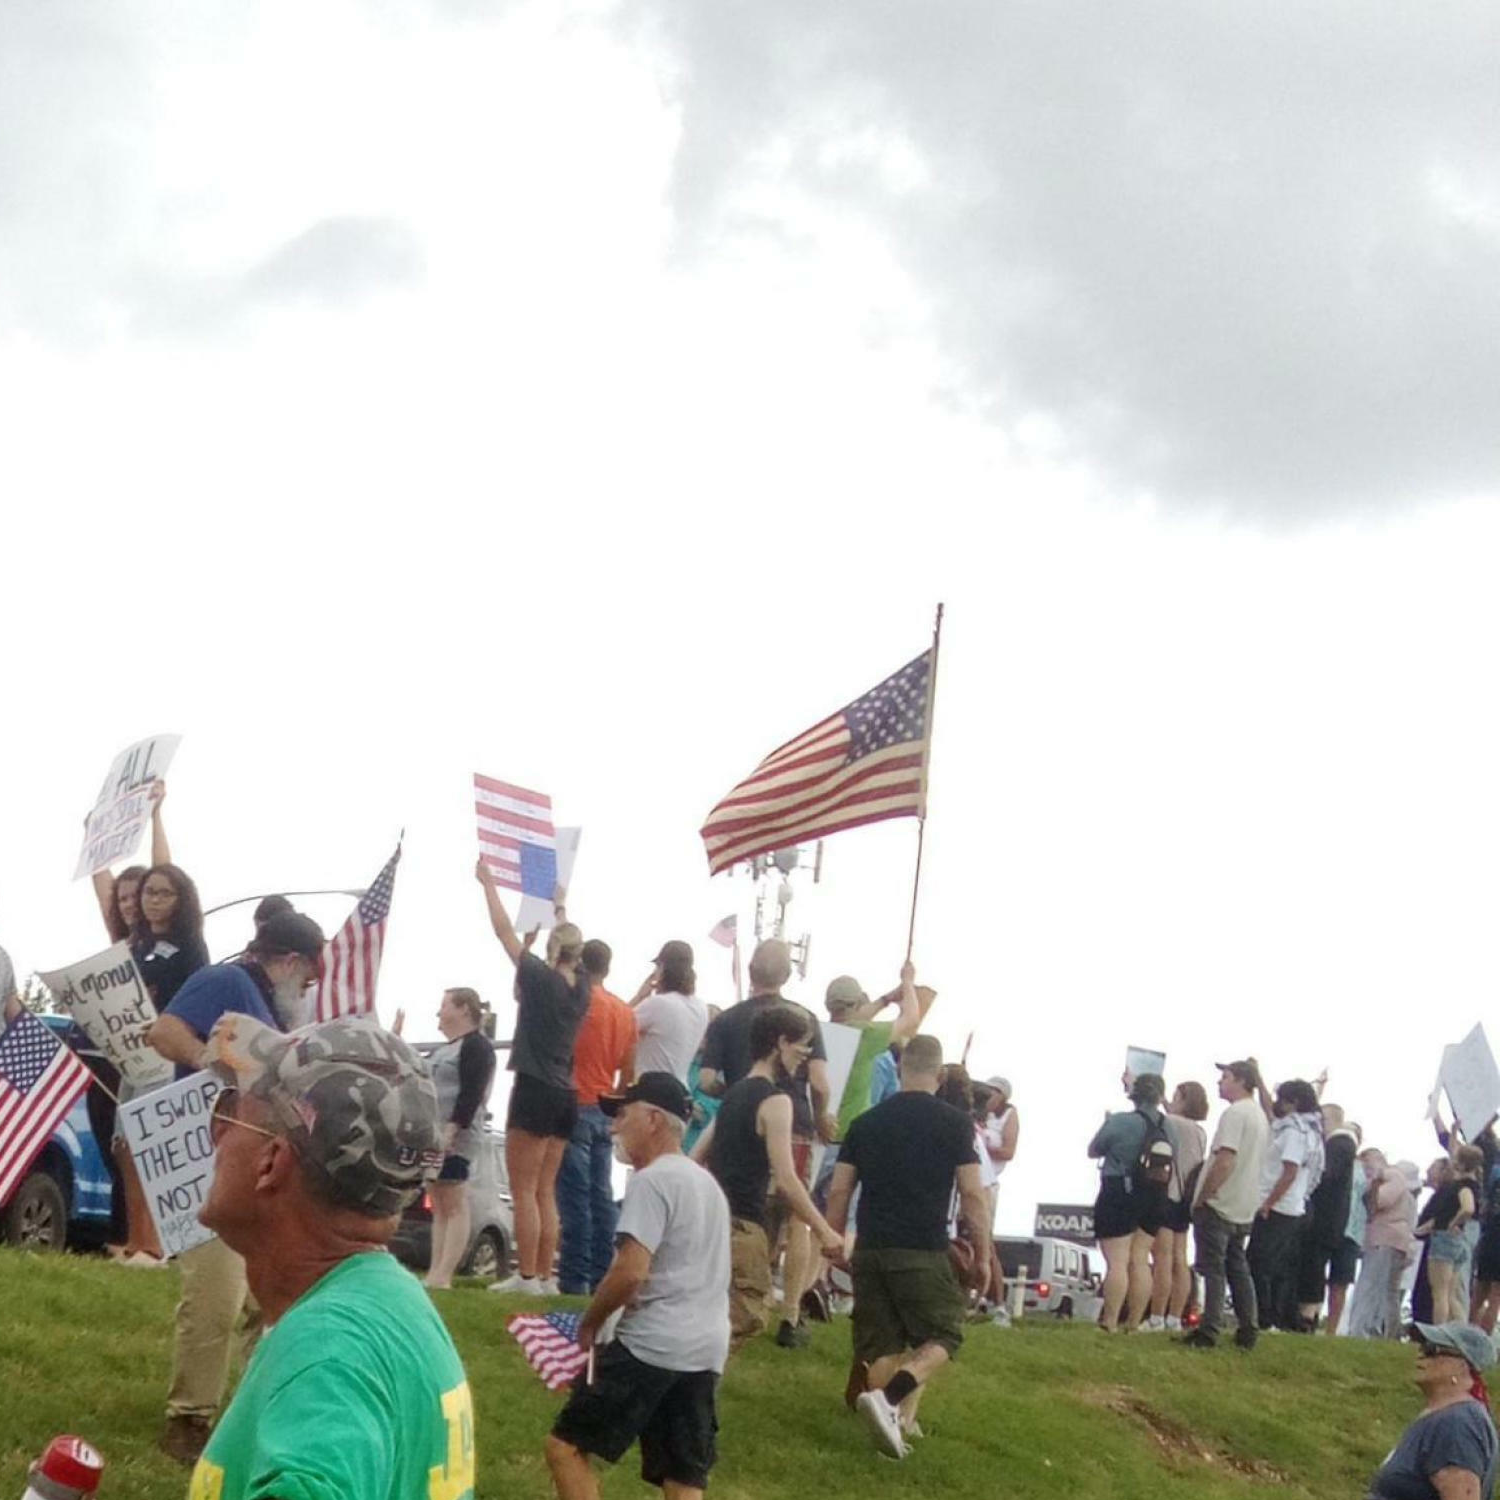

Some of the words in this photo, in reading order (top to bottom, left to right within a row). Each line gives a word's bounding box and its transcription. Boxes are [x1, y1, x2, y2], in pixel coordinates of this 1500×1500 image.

[116, 740, 157, 796] ALL
[99, 1000, 151, 1035] but
[129, 1107, 154, 1141] I
[155, 1081, 219, 1129] SWOR
[134, 1137, 188, 1182] THE
[156, 1173, 206, 1219] NOT
